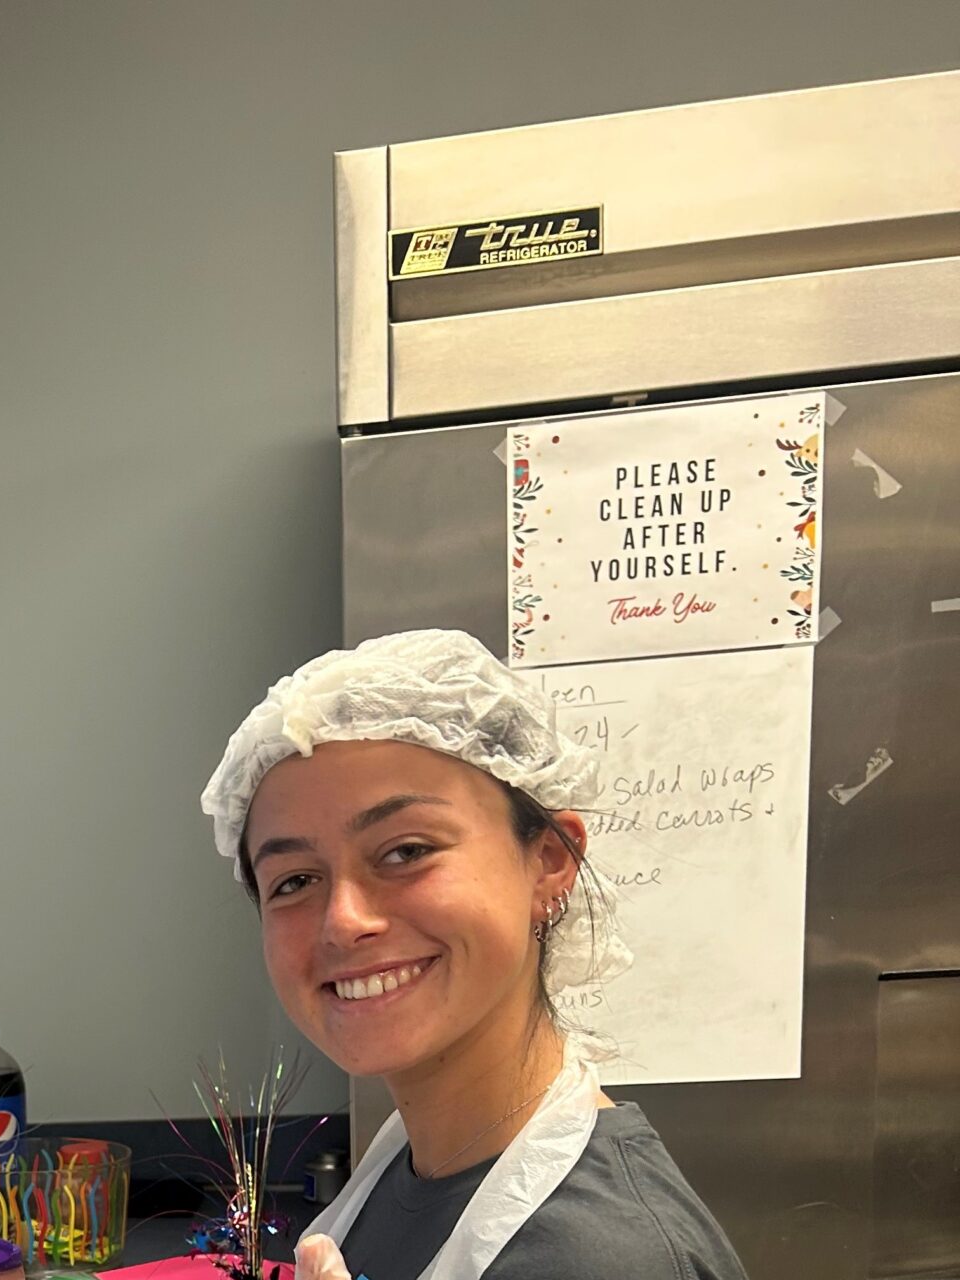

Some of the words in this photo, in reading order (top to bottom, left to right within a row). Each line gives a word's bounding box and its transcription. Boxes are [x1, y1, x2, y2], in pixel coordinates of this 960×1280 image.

[479, 240, 588, 265] REFRIGERATOR
[615, 458, 717, 490] PLEASE
[599, 492, 683, 522] CLEAN
[700, 488, 731, 513] UP
[623, 521, 705, 551] AFTER
[590, 549, 737, 583] YOURSELF.
[607, 595, 667, 625] Thank
[672, 592, 716, 624] You
[613, 764, 683, 806] Salad
